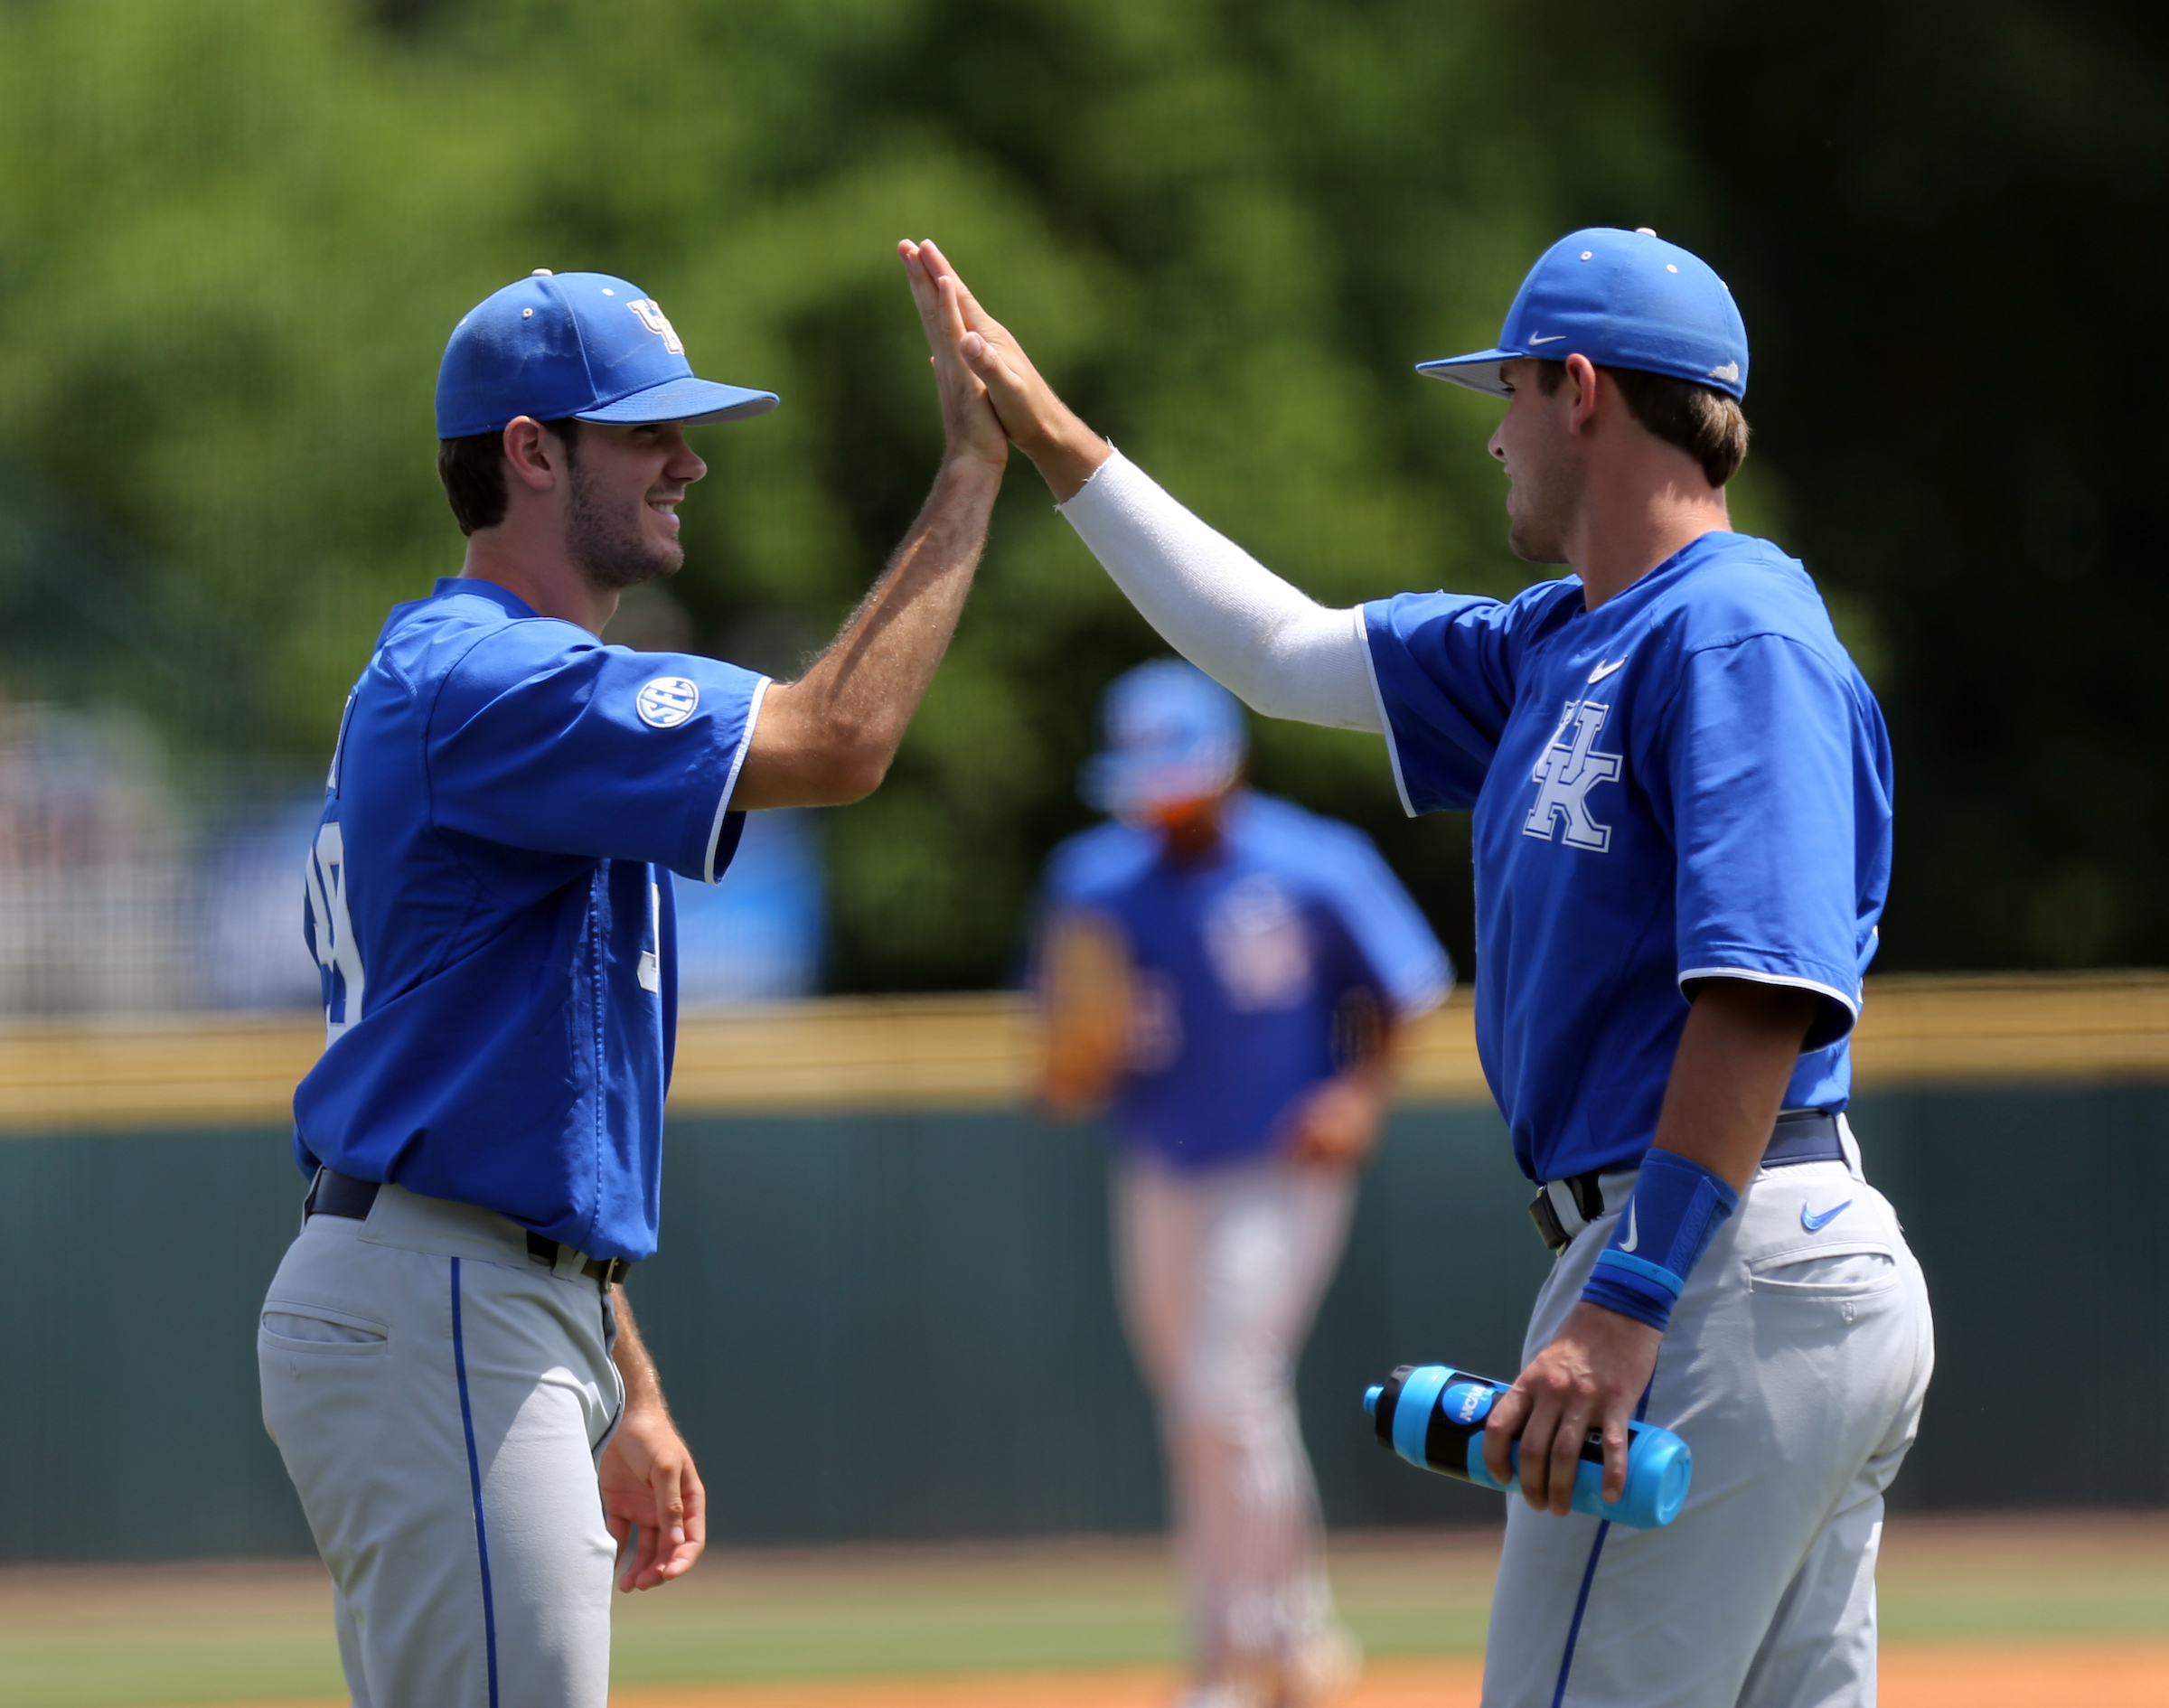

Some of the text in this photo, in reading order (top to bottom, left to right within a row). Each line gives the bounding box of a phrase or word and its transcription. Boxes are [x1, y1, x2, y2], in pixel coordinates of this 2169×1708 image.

[639, 678, 696, 725] SEC
[1522, 699, 1624, 853] UK
[1459, 1384, 1488, 1422] NCAA
